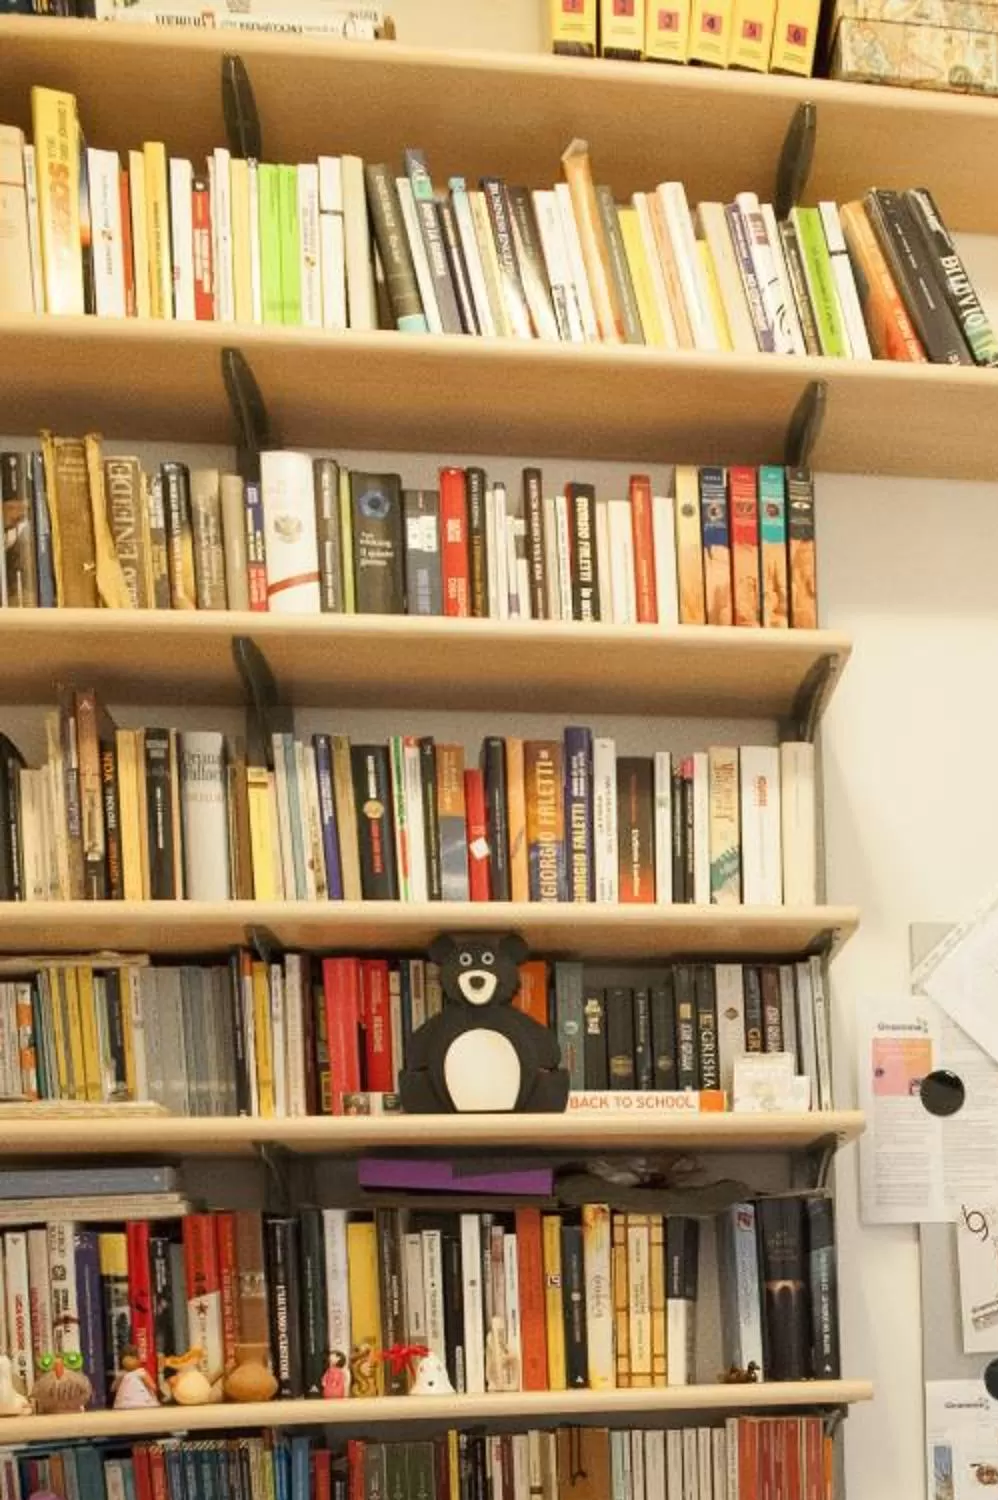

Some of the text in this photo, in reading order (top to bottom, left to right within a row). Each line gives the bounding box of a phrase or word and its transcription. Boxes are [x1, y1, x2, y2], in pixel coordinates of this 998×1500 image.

[108, 462, 138, 560] ENEIDE
[534, 760, 558, 898] GIORGIO FALETTI
[571, 802, 587, 851] FALETTI
[701, 1031, 717, 1088] GRISHA
[570, 1096, 694, 1110] BACK TO SCHOOL
